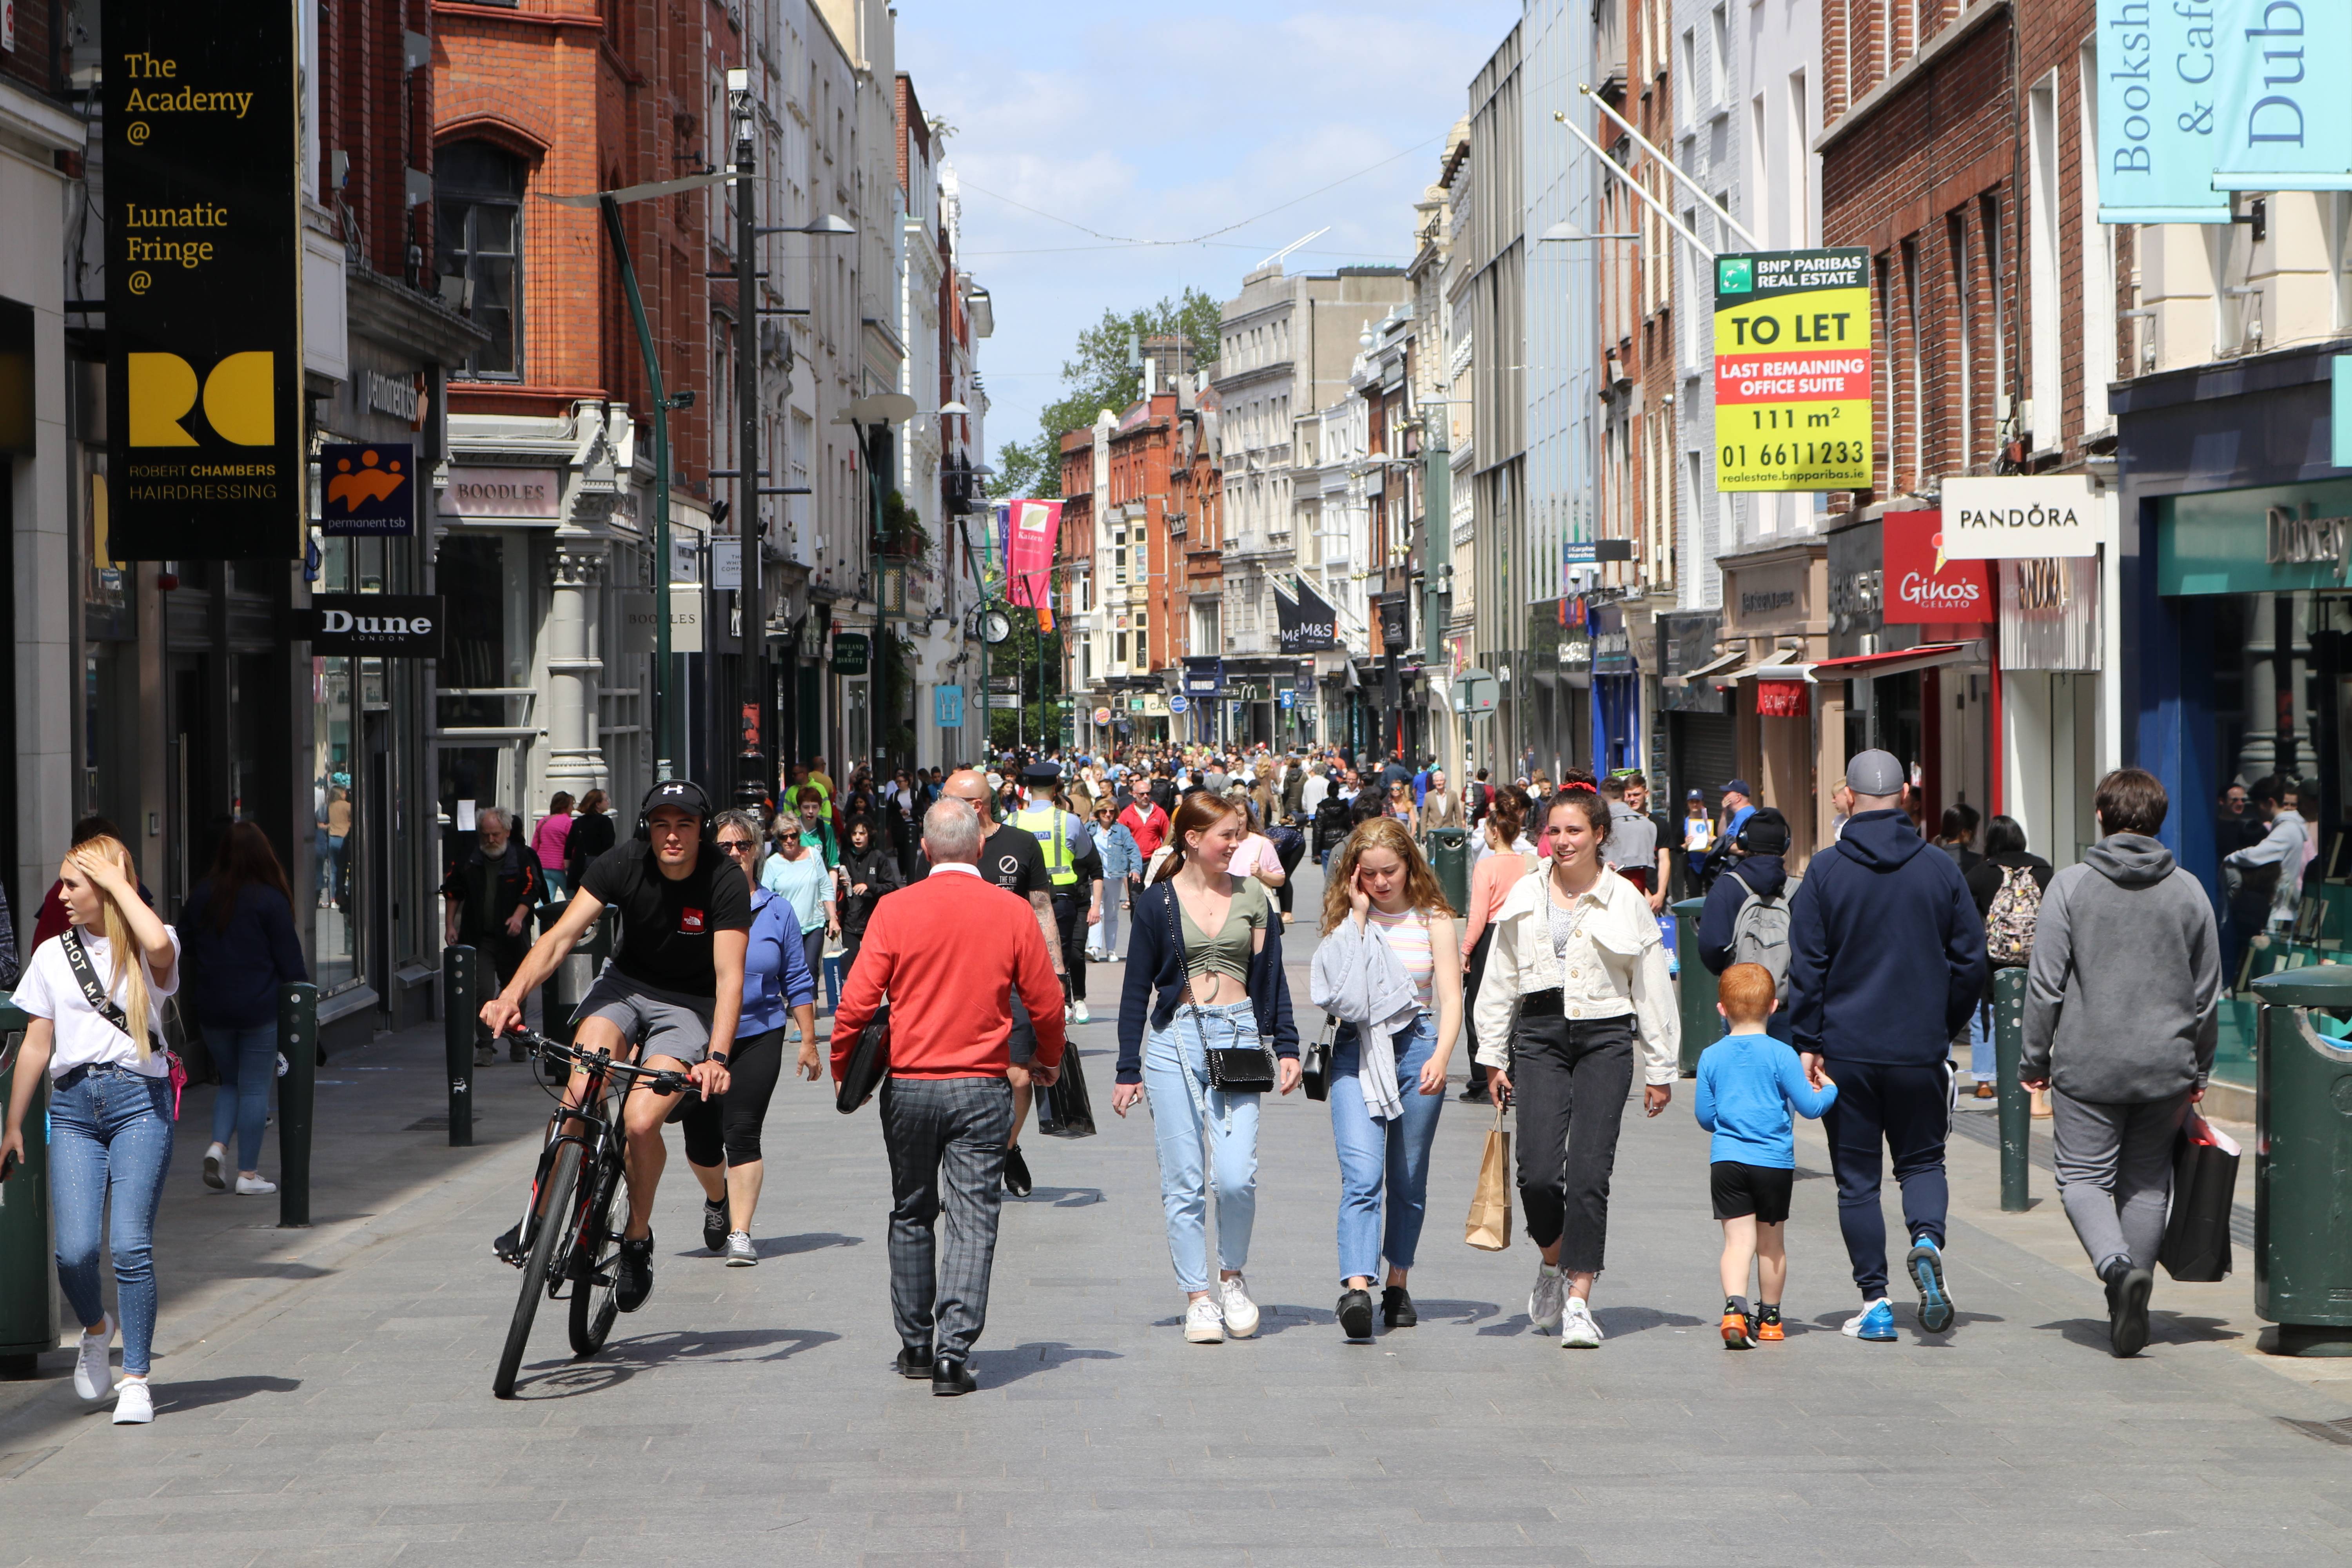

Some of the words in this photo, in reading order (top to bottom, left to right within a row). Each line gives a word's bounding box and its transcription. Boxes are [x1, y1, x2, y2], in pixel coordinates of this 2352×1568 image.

[2173, 0, 2214, 83] Caf
[125, 54, 177, 79] The
[125, 86, 254, 118] Academy
[2178, 100, 2214, 135] &
[127, 121, 151, 145] @
[126, 202, 228, 227] Lunatic
[126, 237, 214, 269] Fringe
[1757, 260, 1791, 274] BNP
[1794, 256, 1863, 272] PARIBAS
[128, 270, 152, 295] @
[1757, 274, 1798, 289] REAL
[1800, 271, 1857, 287] ESTATE
[1731, 315, 1780, 345] TO
[1795, 312, 1850, 343] LET
[1720, 363, 1760, 379] LAST
[1763, 358, 1864, 377] REMAINING
[367, 369, 407, 419] permanent
[1740, 379, 1795, 396] OFFICE
[1798, 377, 1845, 393] SUITE
[1722, 445, 1747, 467] 01
[1760, 441, 1864, 466] 6611233
[130, 465, 187, 477] ROBERT
[190, 464, 276, 477] CHAMBERS
[1722, 469, 1864, 483] realestate.bnpparibas.ie
[130, 484, 277, 500] HAIRDRESSING
[457, 483, 545, 500] BOODLES
[328, 516, 387, 530] permanent
[390, 517, 406, 528] tsb
[1960, 503, 2078, 528] PANDORA
[1018, 531, 1043, 542] Kaizen
[1900, 572, 1980, 603] Gino's
[1921, 600, 1970, 609] GELATO
[322, 610, 432, 634] Dune
[629, 614, 695, 624] BOOLES
[1301, 622, 1332, 637] M&S
[1281, 629, 1299, 642] M&
[62, 929, 87, 971] SHOT
